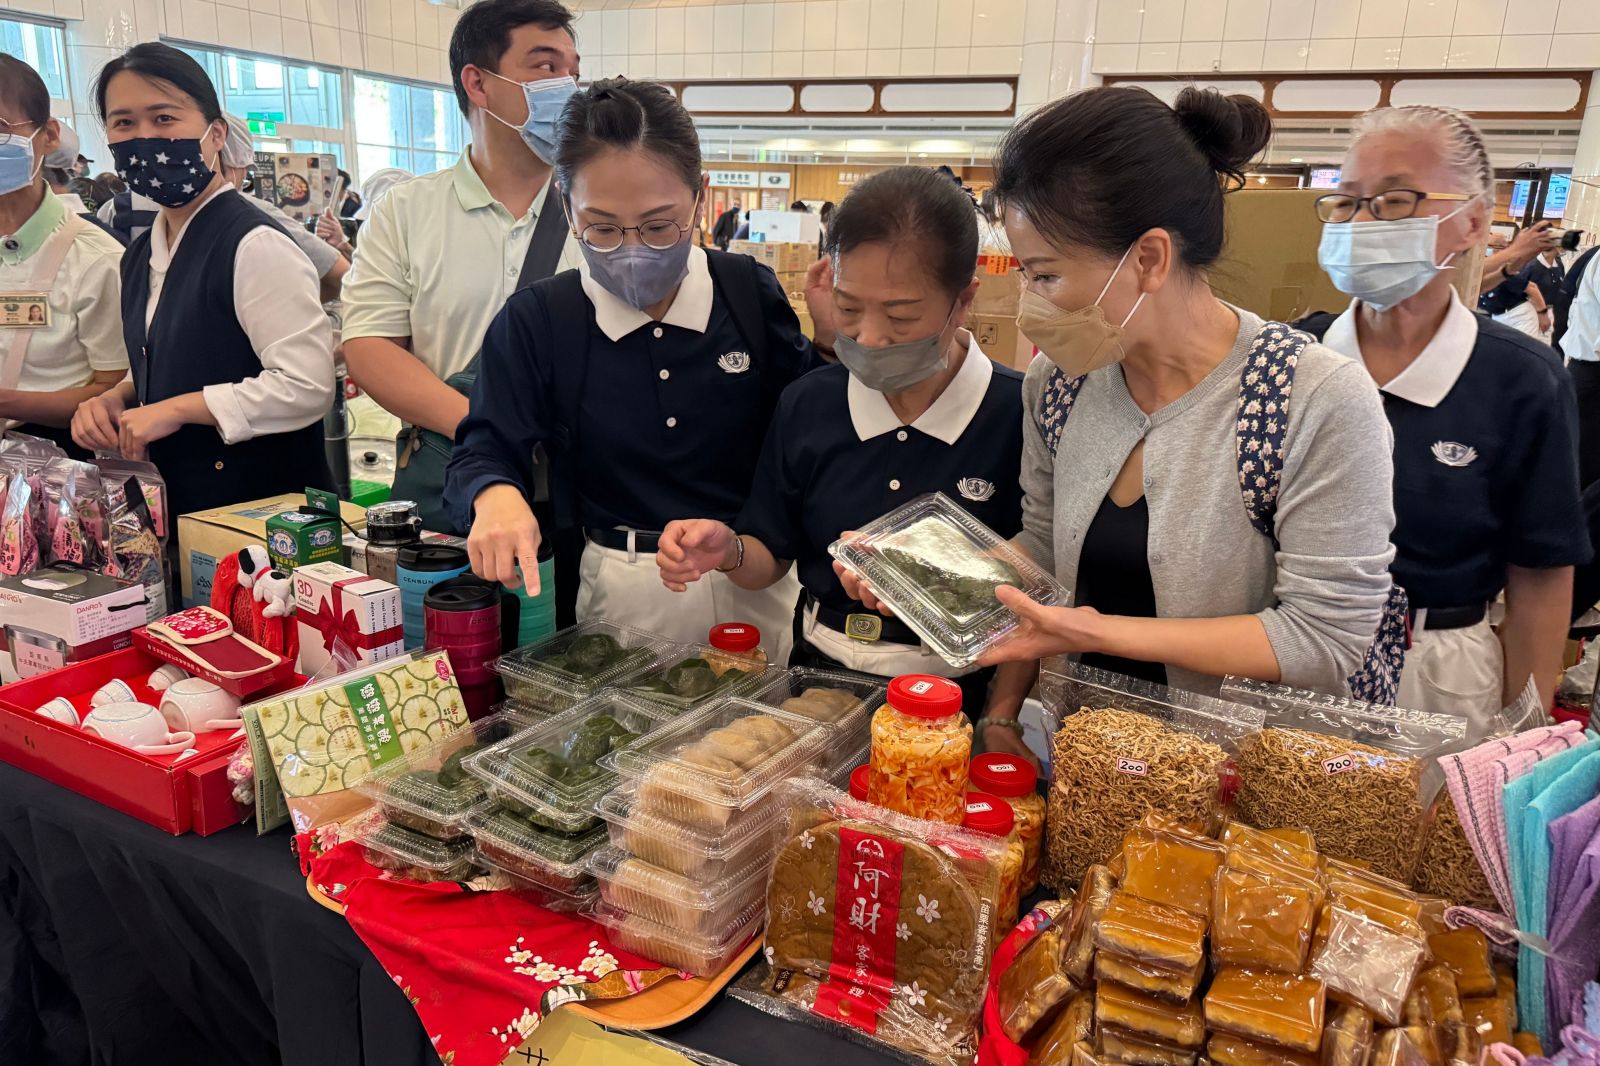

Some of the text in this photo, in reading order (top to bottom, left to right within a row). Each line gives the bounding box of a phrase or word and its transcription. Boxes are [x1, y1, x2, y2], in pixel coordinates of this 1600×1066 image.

[297, 578, 313, 598] 3D
[1119, 760, 1143, 773] 200
[1326, 758, 1351, 773] 200
[849, 861, 890, 935] 阿財
